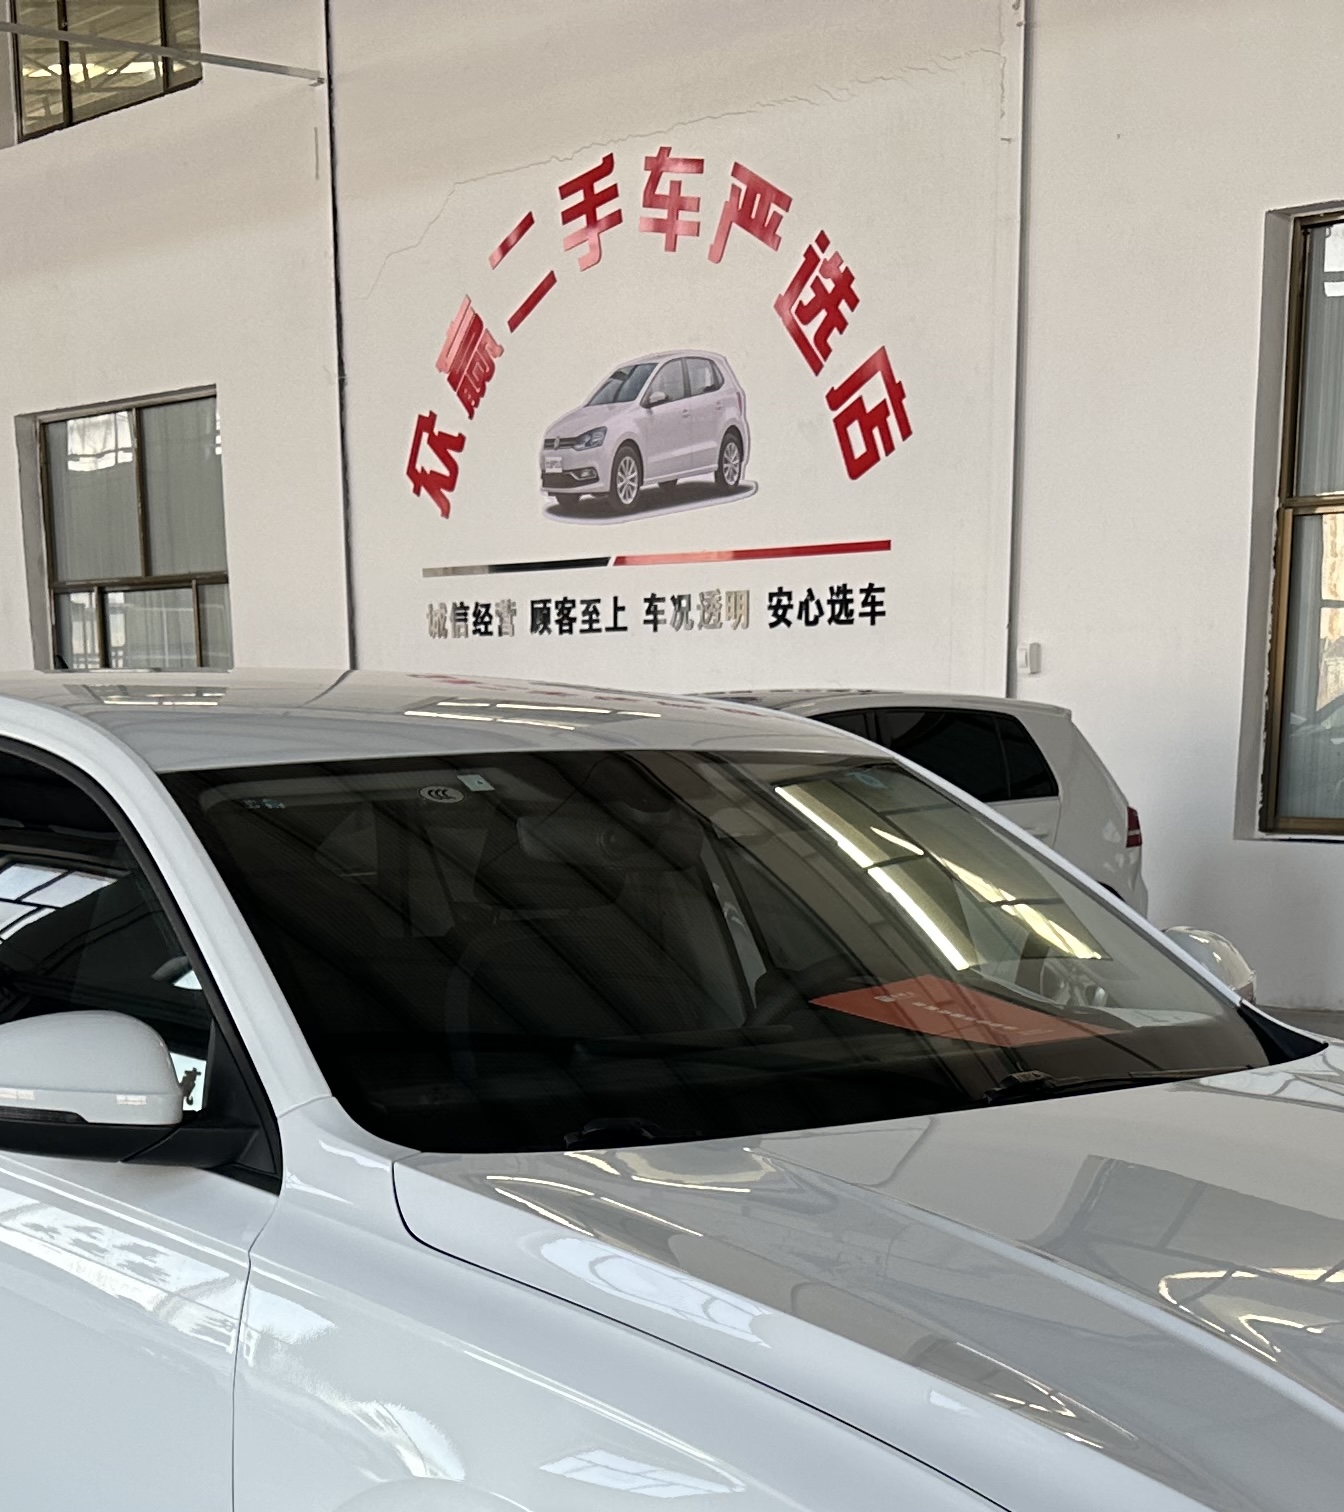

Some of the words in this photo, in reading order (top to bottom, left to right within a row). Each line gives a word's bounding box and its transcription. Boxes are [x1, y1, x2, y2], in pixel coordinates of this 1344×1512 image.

[406, 146, 913, 519] 众赢二手车严选店
[426, 598, 517, 639] 诚信经营
[529, 595, 628, 635] 顾客至上
[643, 588, 750, 633] 车况透明
[767, 582, 886, 628] 安心选车
